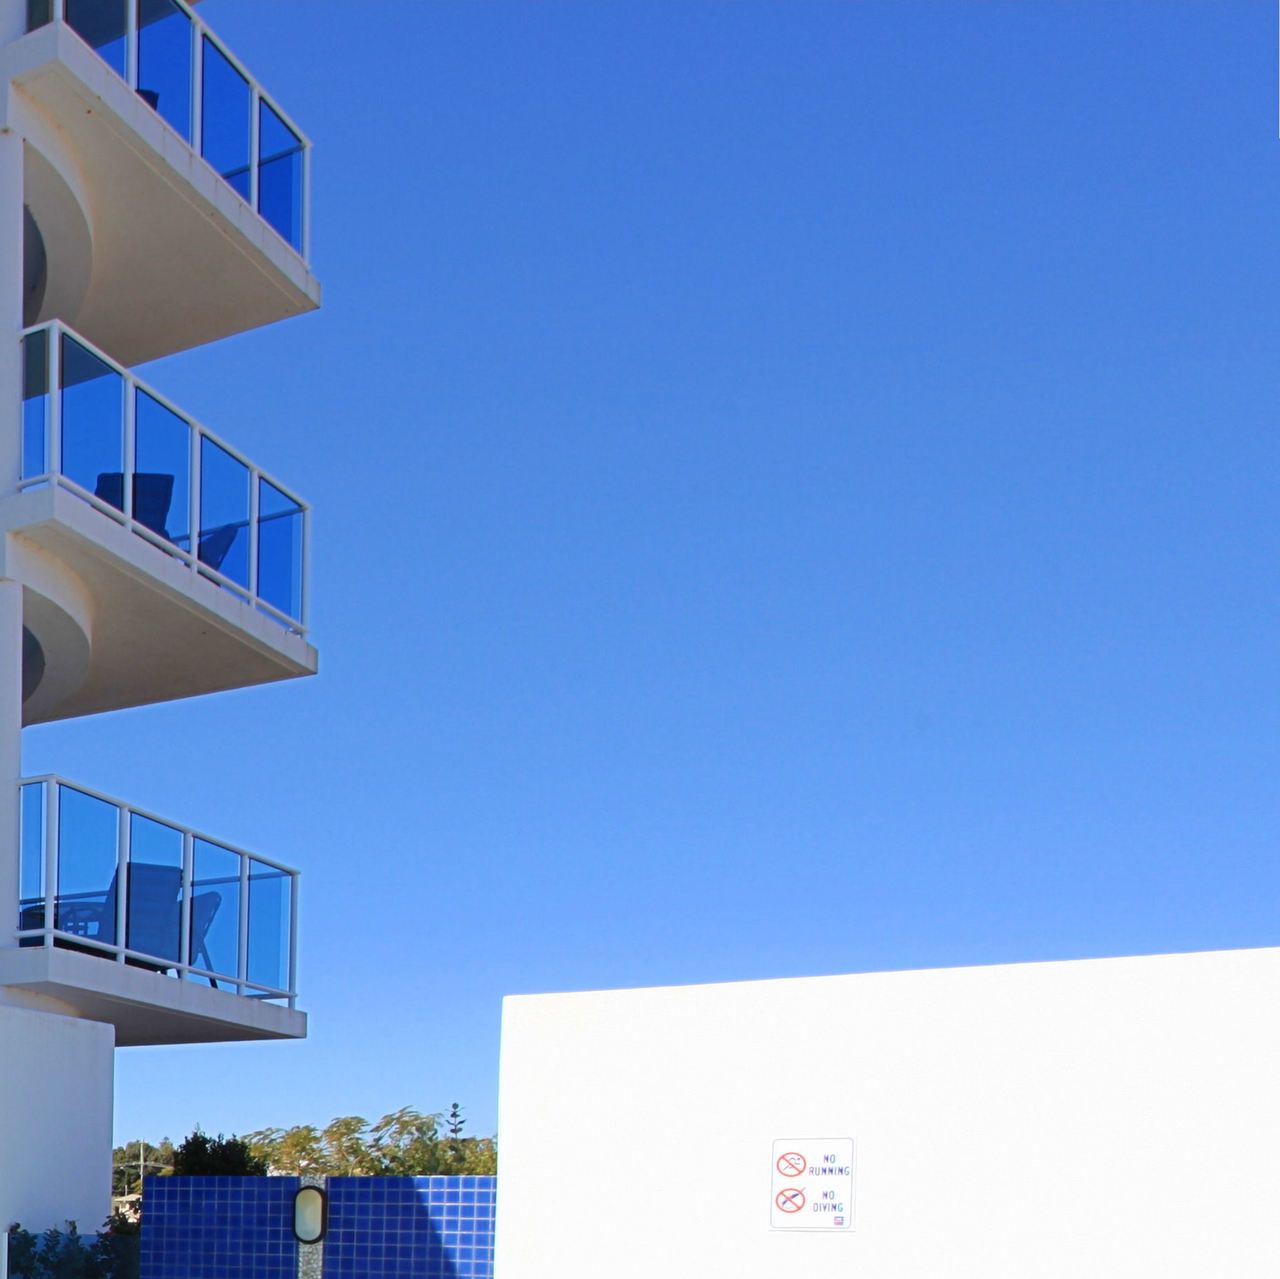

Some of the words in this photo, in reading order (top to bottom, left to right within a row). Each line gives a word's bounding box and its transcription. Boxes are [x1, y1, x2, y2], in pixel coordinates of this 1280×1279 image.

[823, 1153, 836, 1164] NO
[808, 1166, 850, 1176] RUNNING
[822, 1190, 835, 1201] NO
[812, 1202, 844, 1212] DIVING
